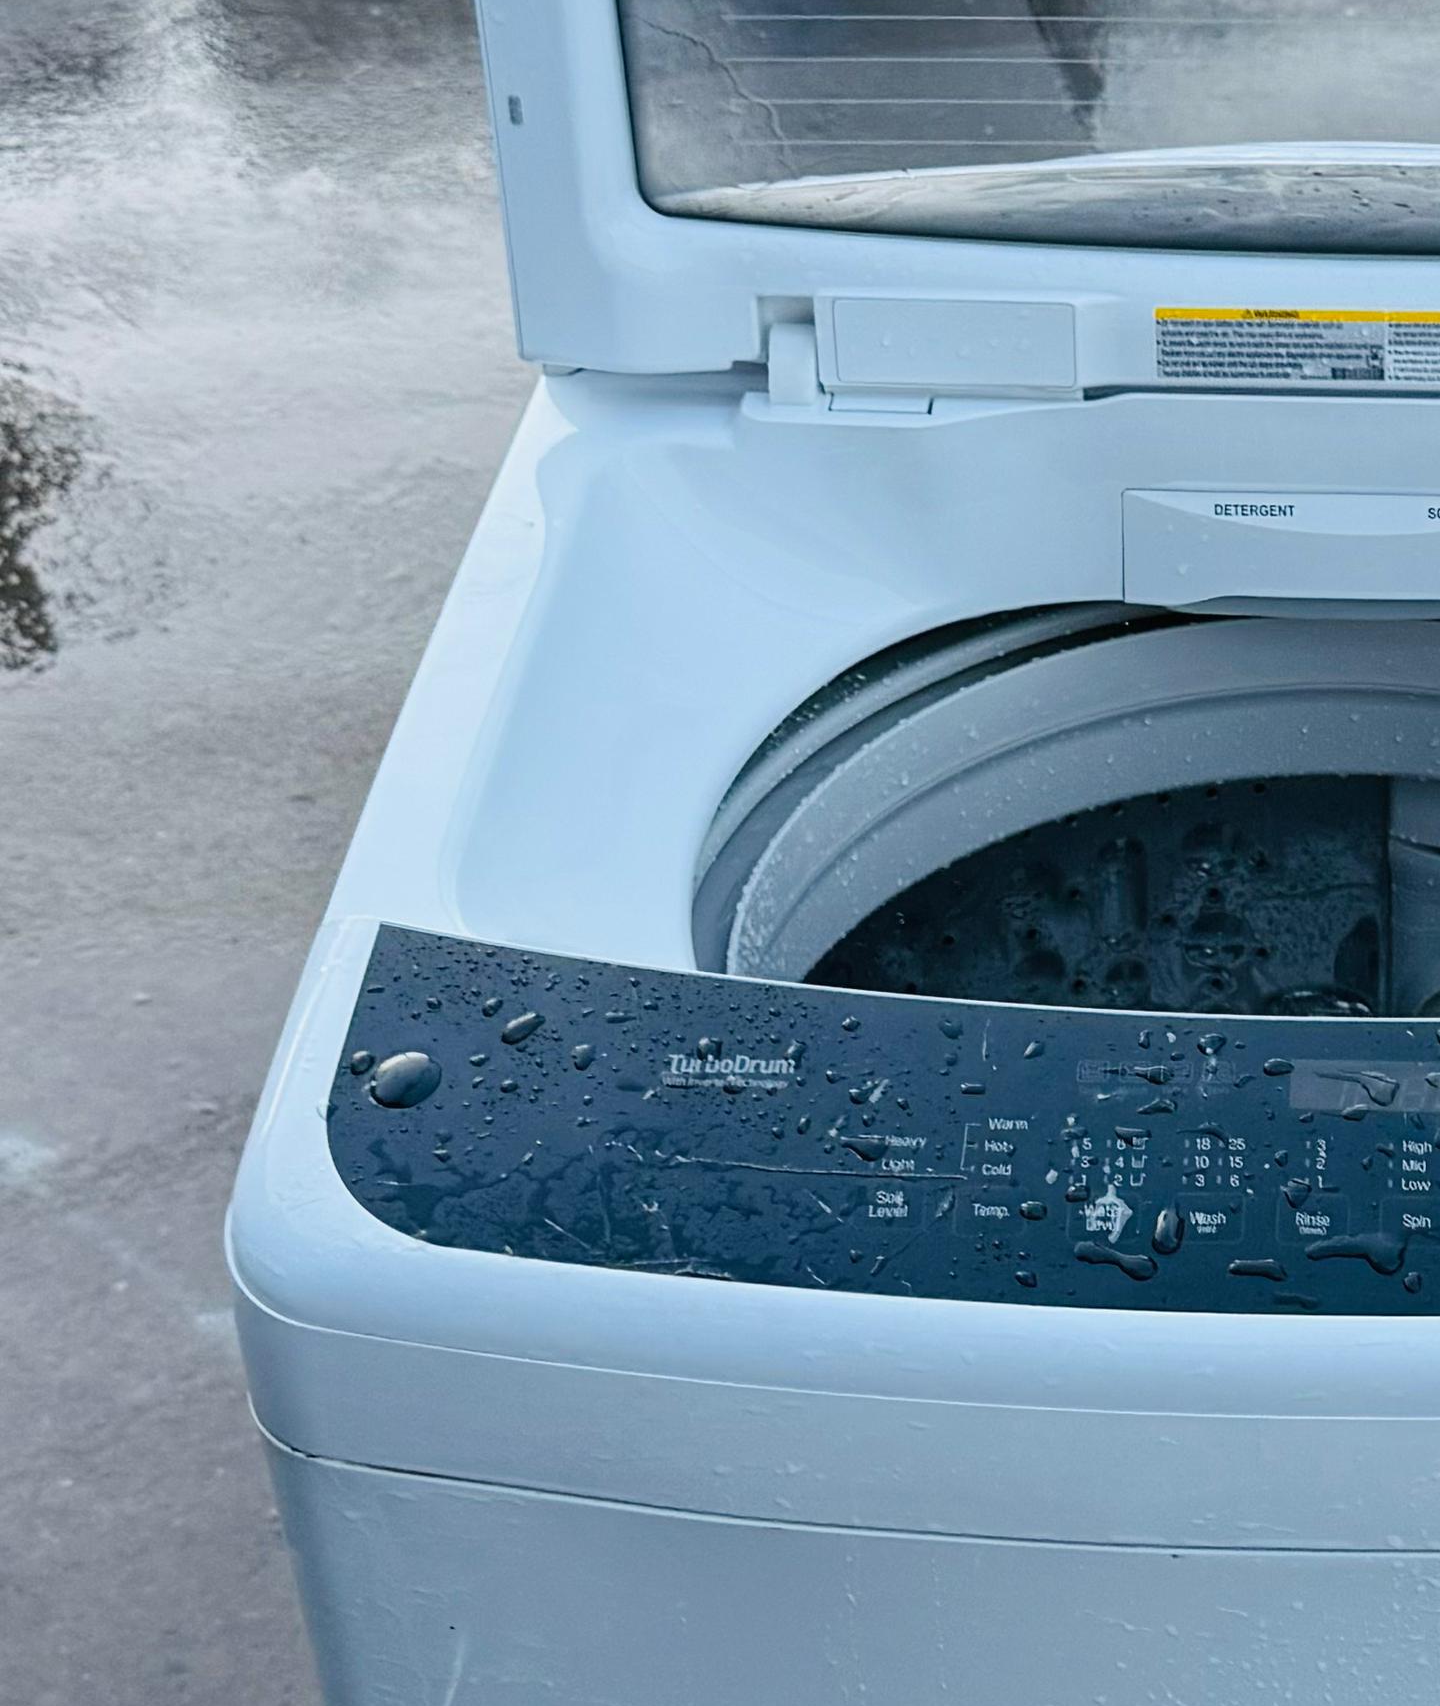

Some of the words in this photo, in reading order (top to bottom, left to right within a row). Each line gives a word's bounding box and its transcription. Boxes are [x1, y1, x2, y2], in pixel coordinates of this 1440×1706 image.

[1213, 503, 1295, 518] DETERGENT
[668, 1053, 796, 1074] TurboDrum
[988, 1117, 1029, 1131] Warm
[884, 1135, 927, 1149] Heavy
[1081, 1137, 1093, 1150] 5
[1195, 1137, 1211, 1151] 18
[1228, 1137, 1246, 1151] 25
[1402, 1140, 1433, 1155] High
[1080, 1156, 1090, 1168] 3
[1114, 1156, 1125, 1168] 4
[1194, 1156, 1210, 1168] 10
[1229, 1156, 1244, 1168] 15
[1402, 1159, 1426, 1173] Mid
[982, 1163, 1012, 1177] Cold
[1113, 1174, 1123, 1187] 2
[1194, 1175, 1205, 1187] 3
[1229, 1175, 1240, 1187] 6
[1401, 1178, 1431, 1192] Low
[868, 1204, 909, 1219] Level
[1189, 1210, 1227, 1226] Wash
[1295, 1210, 1331, 1227] Rinse
[1402, 1212, 1432, 1230] Spin
